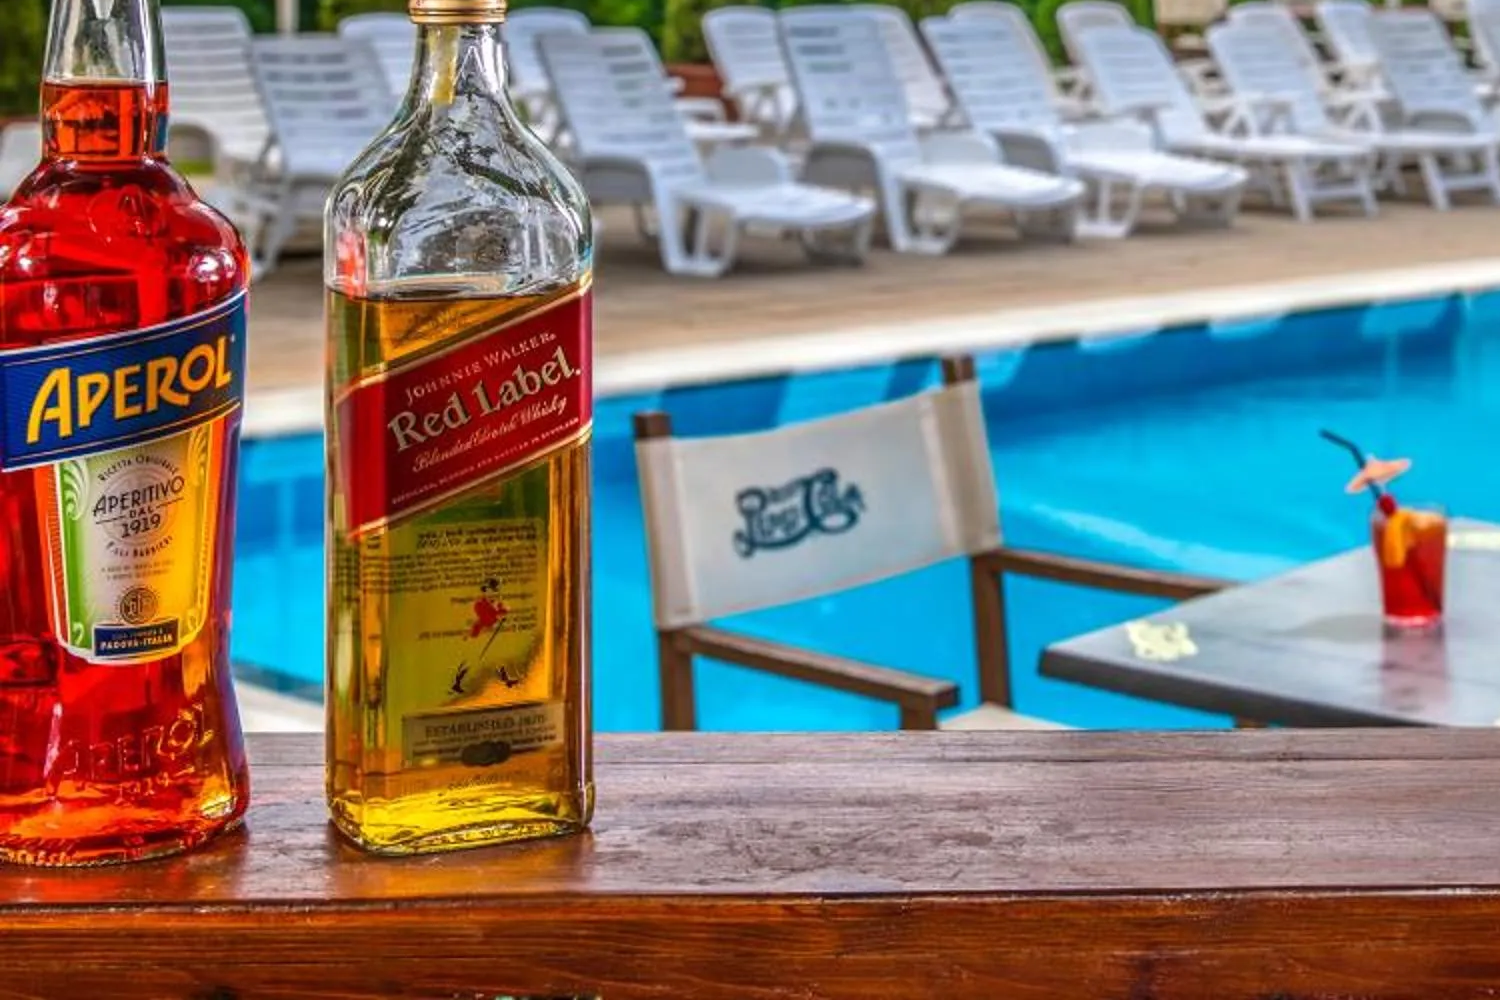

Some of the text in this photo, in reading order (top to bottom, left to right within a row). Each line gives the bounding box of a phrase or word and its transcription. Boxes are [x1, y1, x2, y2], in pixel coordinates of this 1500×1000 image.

[26, 335, 233, 444] APEROL
[387, 392, 472, 452] Red
[93, 475, 185, 517] APERITIVO
[121, 513, 161, 538] 1919
